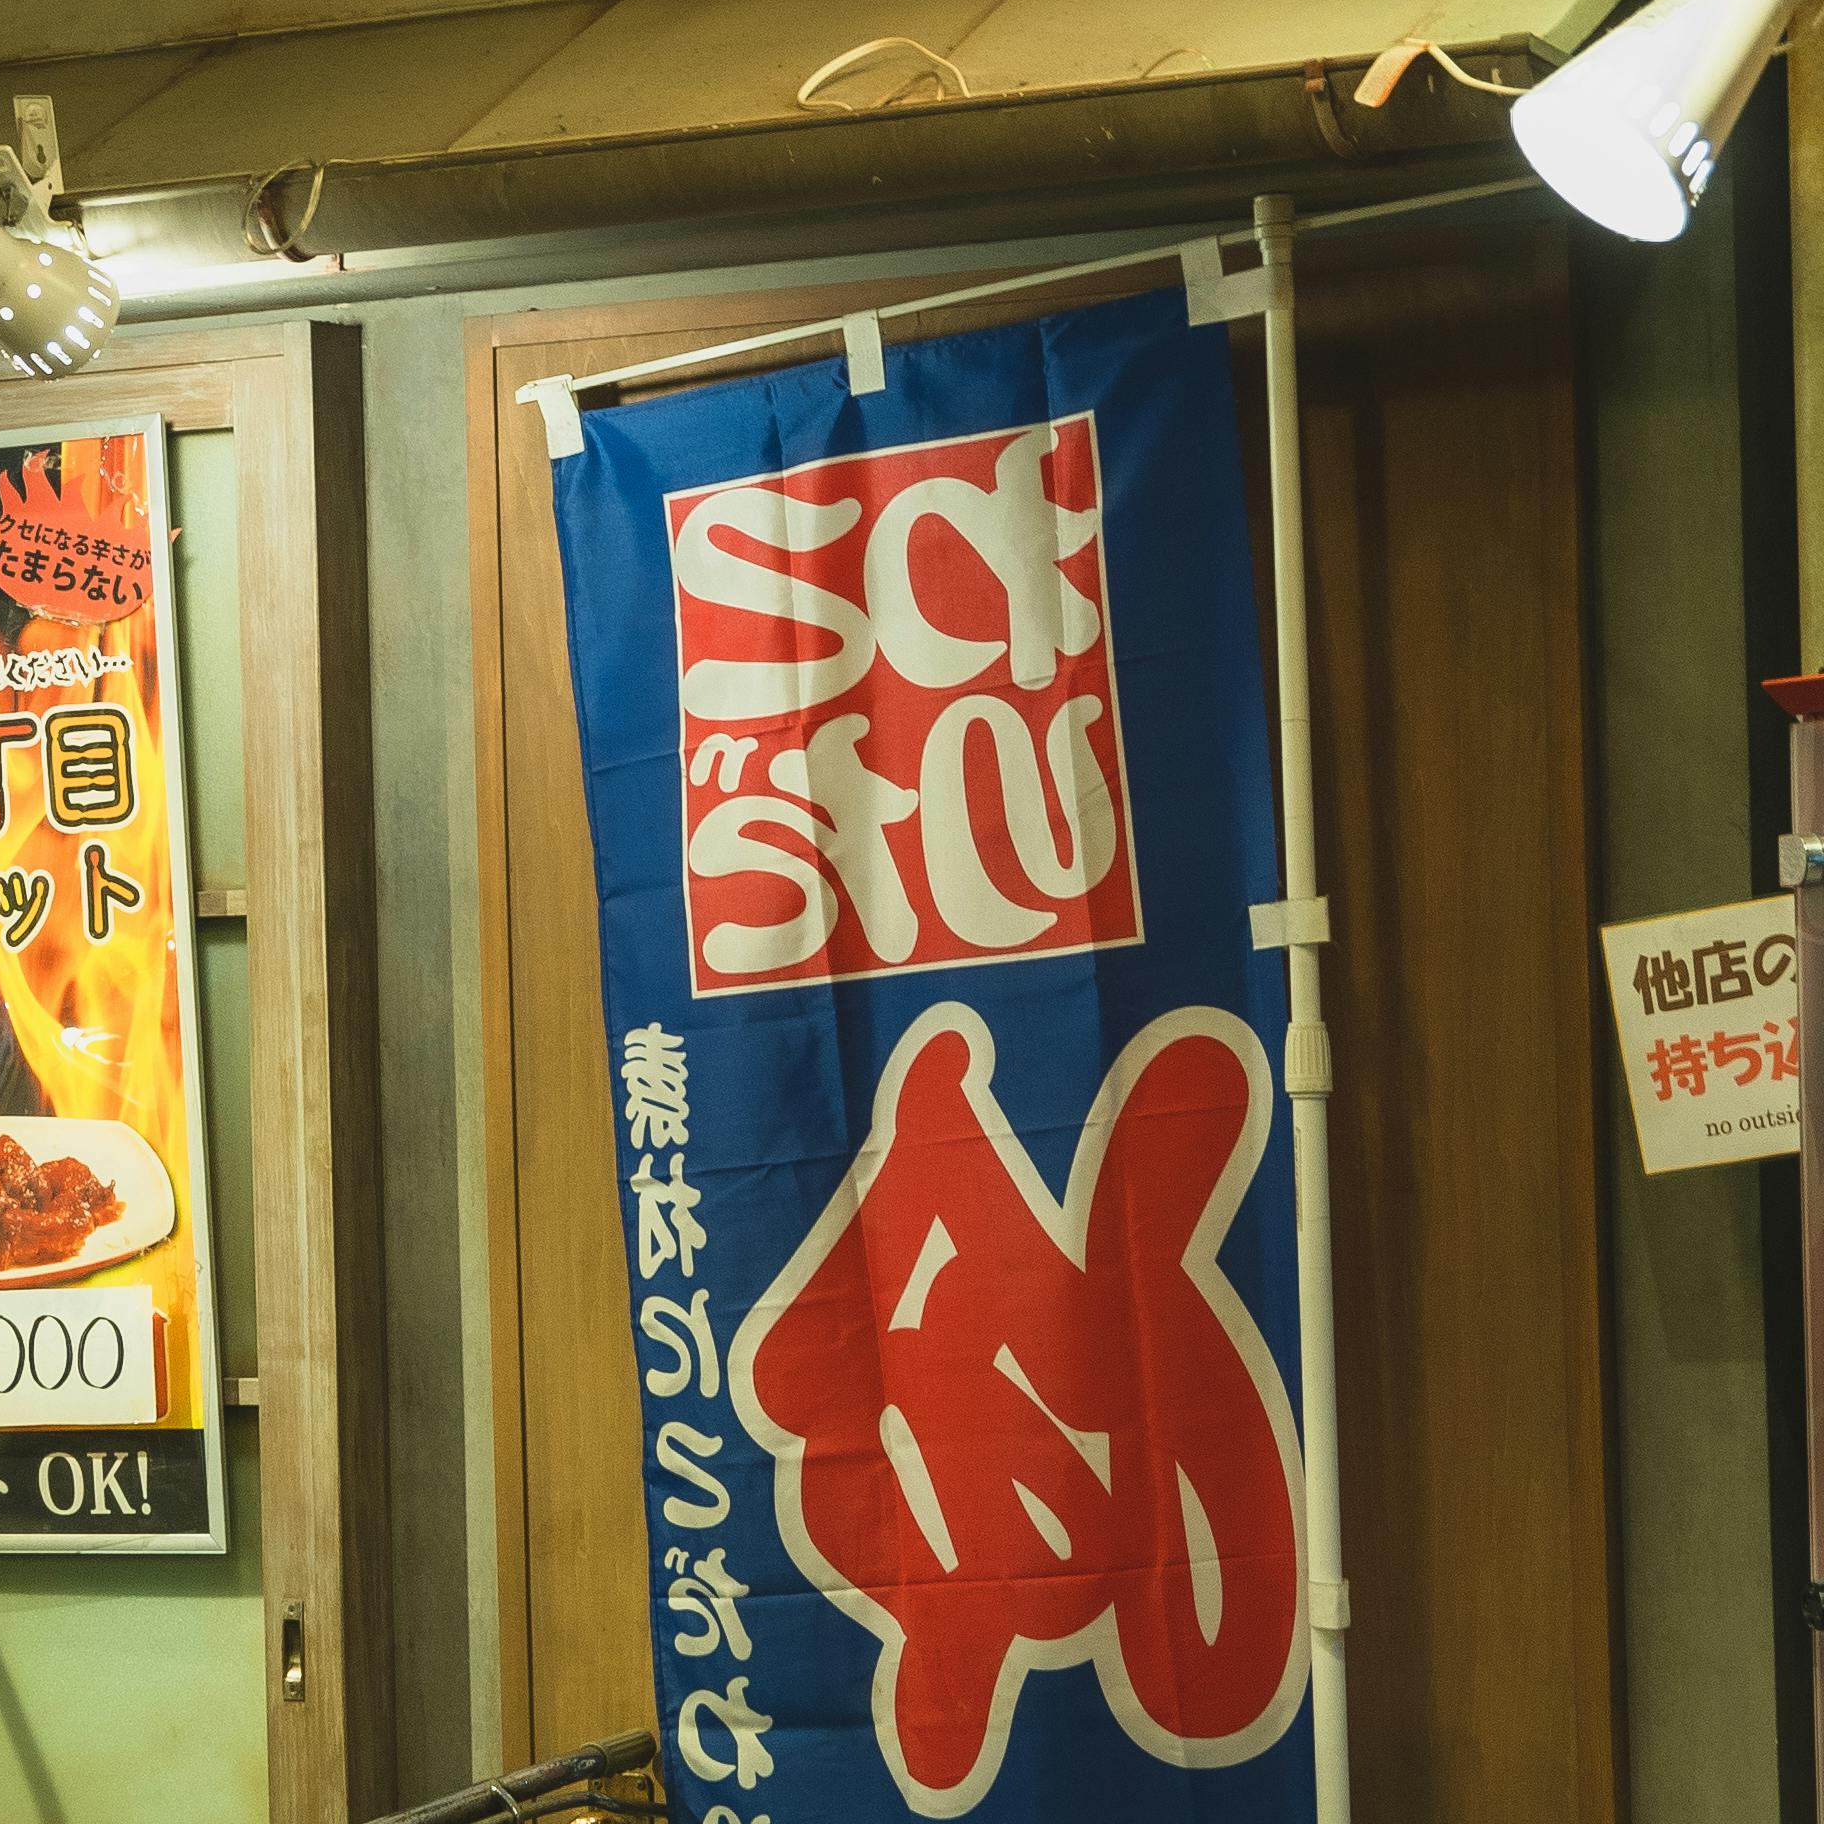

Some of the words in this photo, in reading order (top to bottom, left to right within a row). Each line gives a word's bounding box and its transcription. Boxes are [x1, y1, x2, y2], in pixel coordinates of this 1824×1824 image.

[0, 514, 152, 570] クセになる辛さが
[1632, 934, 1797, 1016] 他店の
[1706, 1117, 1733, 1137] no
[38, 1450, 153, 1517] OK!
